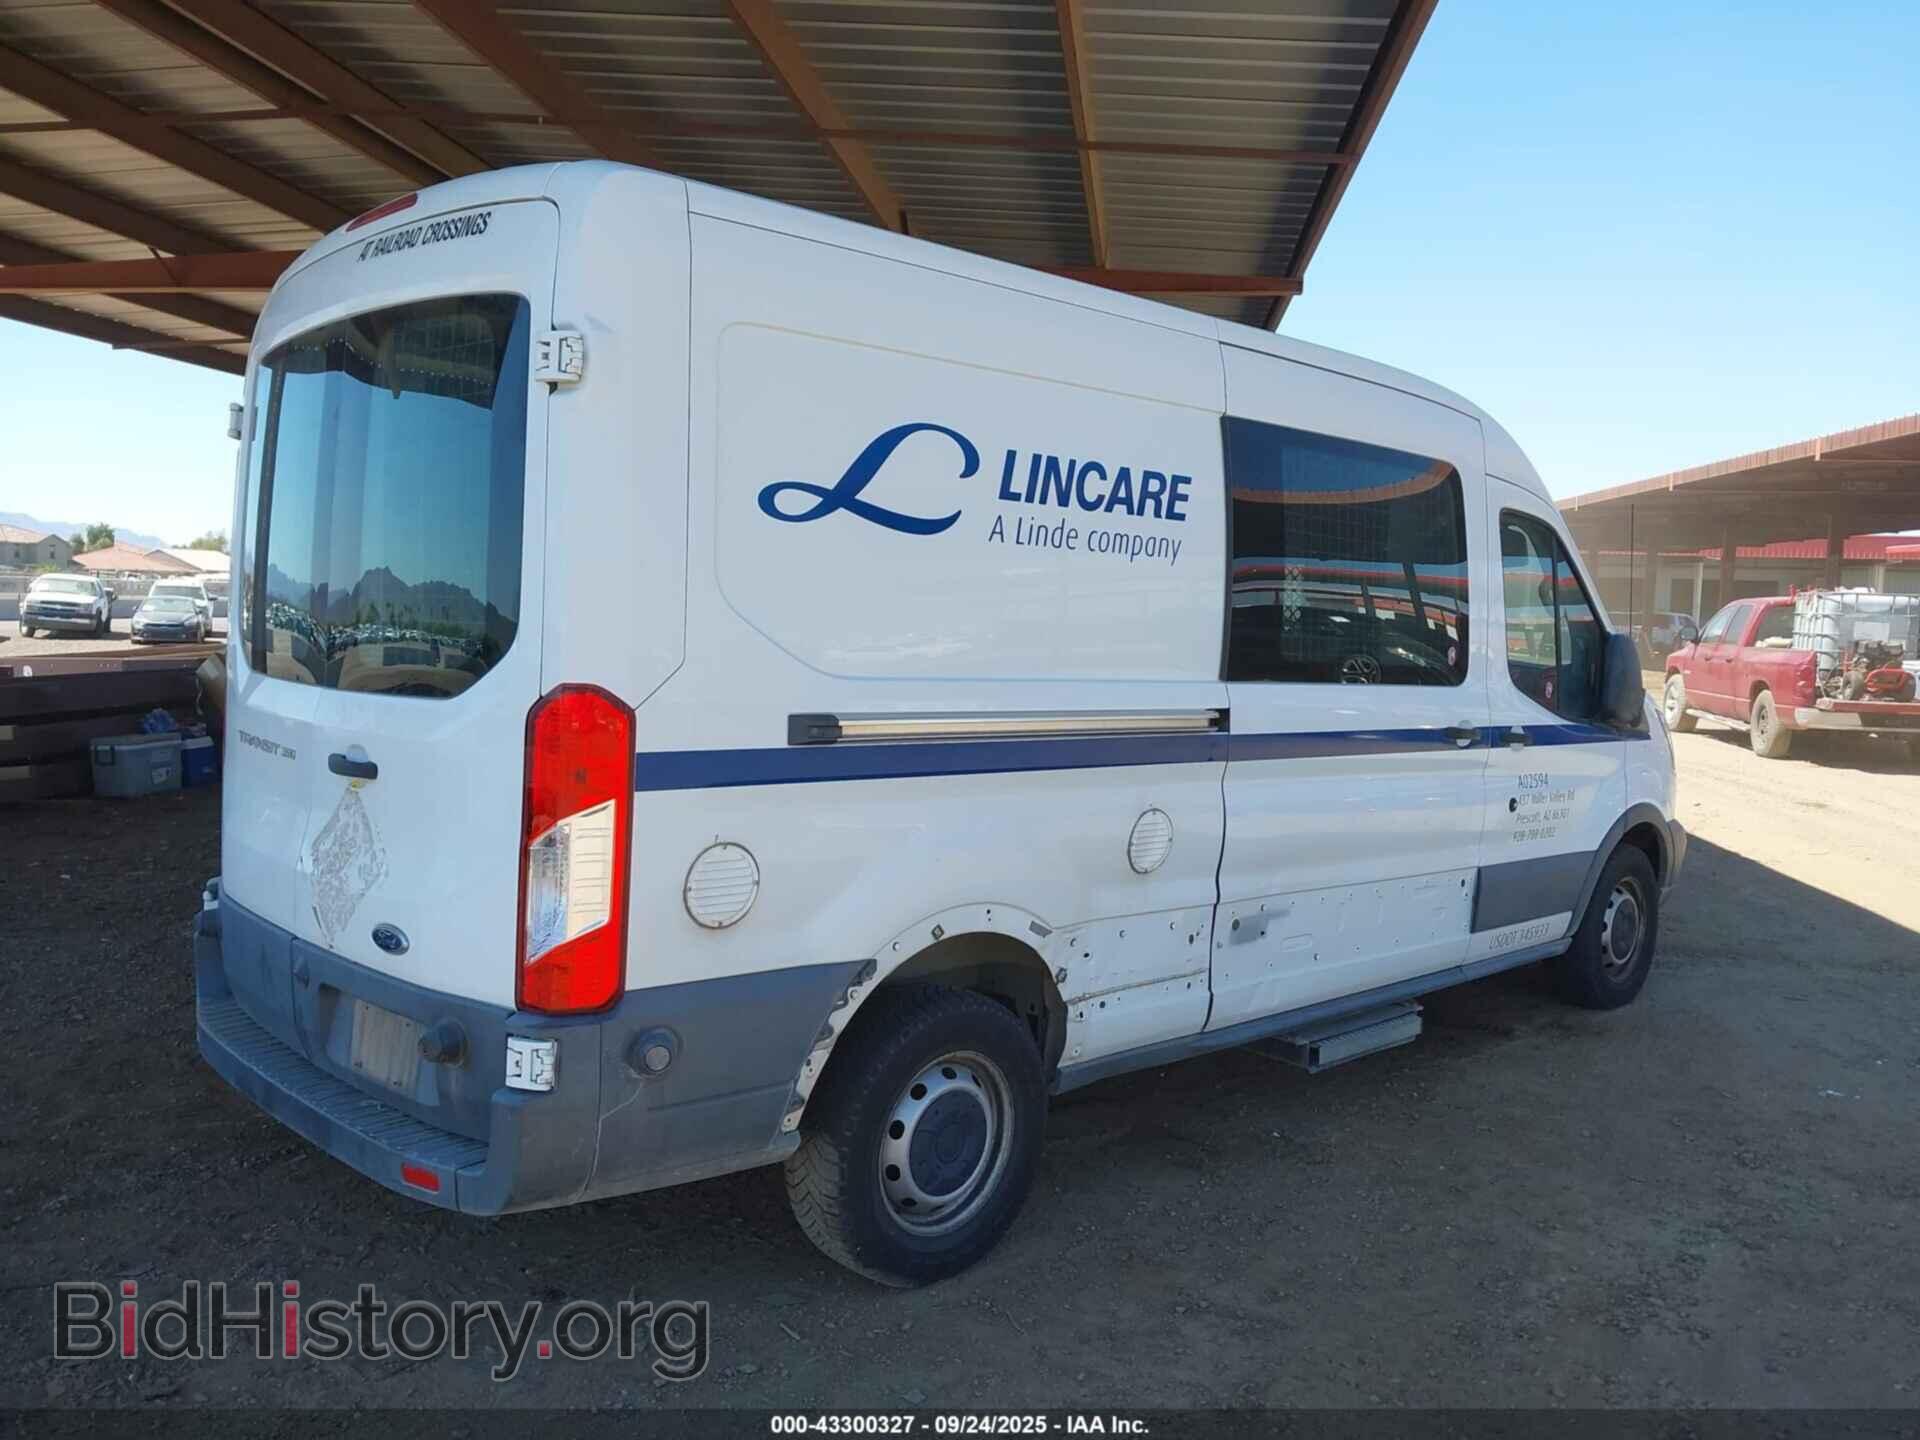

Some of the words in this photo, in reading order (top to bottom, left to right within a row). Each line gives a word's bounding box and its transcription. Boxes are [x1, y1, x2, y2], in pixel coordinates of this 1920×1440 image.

[371, 228, 422, 256] RAILROAD
[422, 211, 492, 245] CROSSINGS
[998, 449, 1192, 522] LINCARE
[988, 514, 1005, 543] A
[1016, 516, 1079, 550] Linde
[1087, 529, 1182, 566] company
[1518, 773, 1549, 789] A02594
